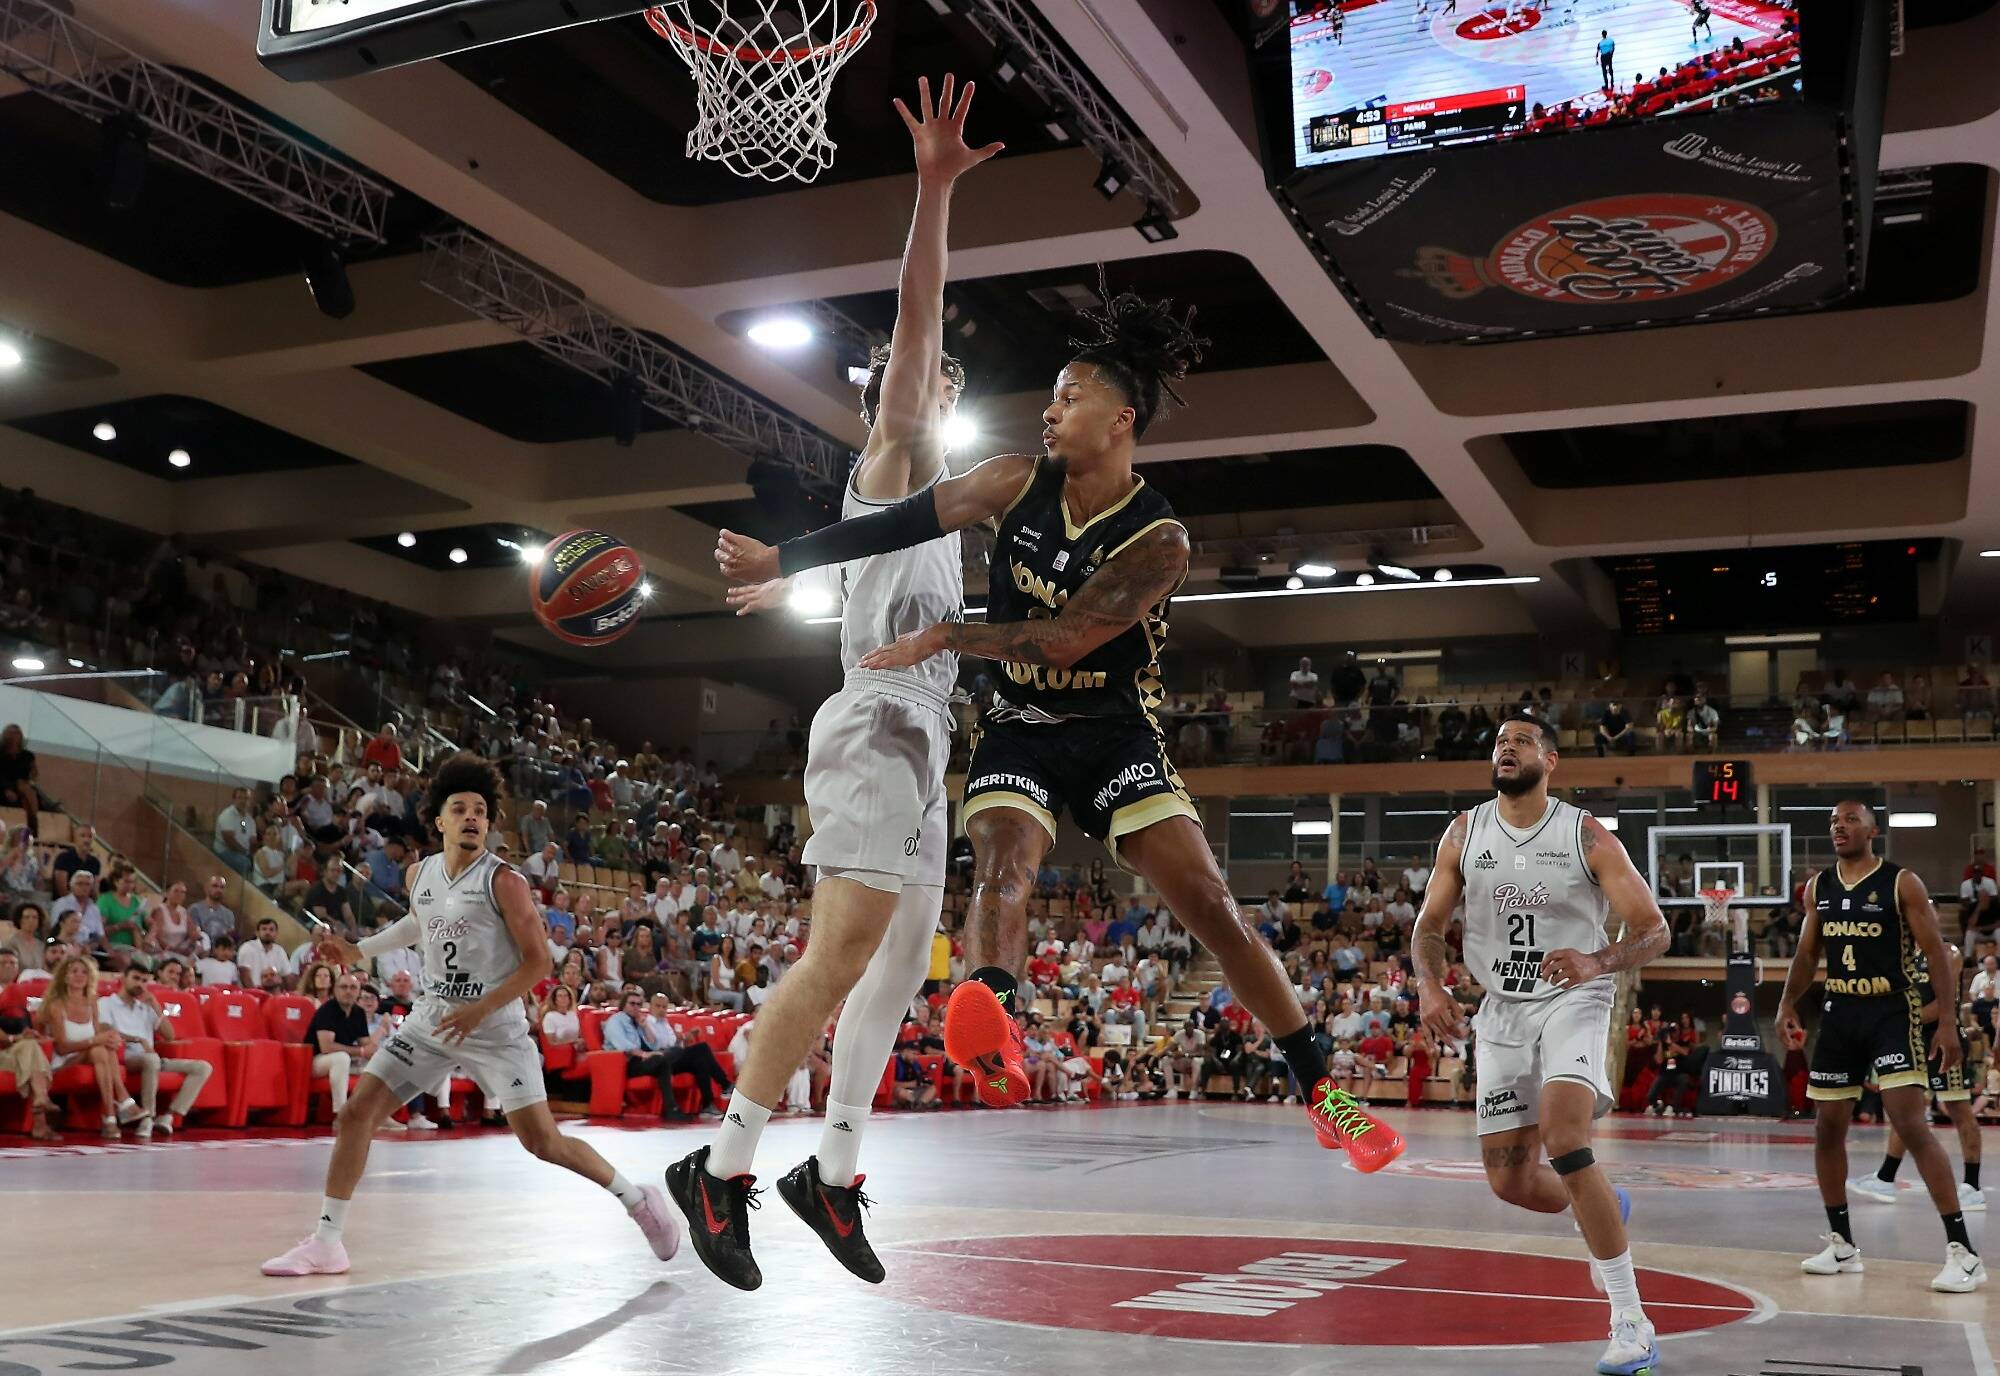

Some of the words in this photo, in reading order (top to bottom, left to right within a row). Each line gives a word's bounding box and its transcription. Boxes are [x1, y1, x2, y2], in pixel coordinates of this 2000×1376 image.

[1506, 87, 1518, 100] 11
[1403, 101, 1436, 115] MONACO
[1507, 106, 1517, 119] 7
[1403, 121, 1427, 132] PARIS
[1721, 210, 1768, 262] BASKET
[1713, 780, 1738, 801] 14
[1493, 881, 1551, 917] Paris
[1507, 913, 1536, 947] 21
[443, 941, 459, 970] 2
[1841, 944, 1857, 971] 4
[1708, 1069, 1769, 1096] FINALES
